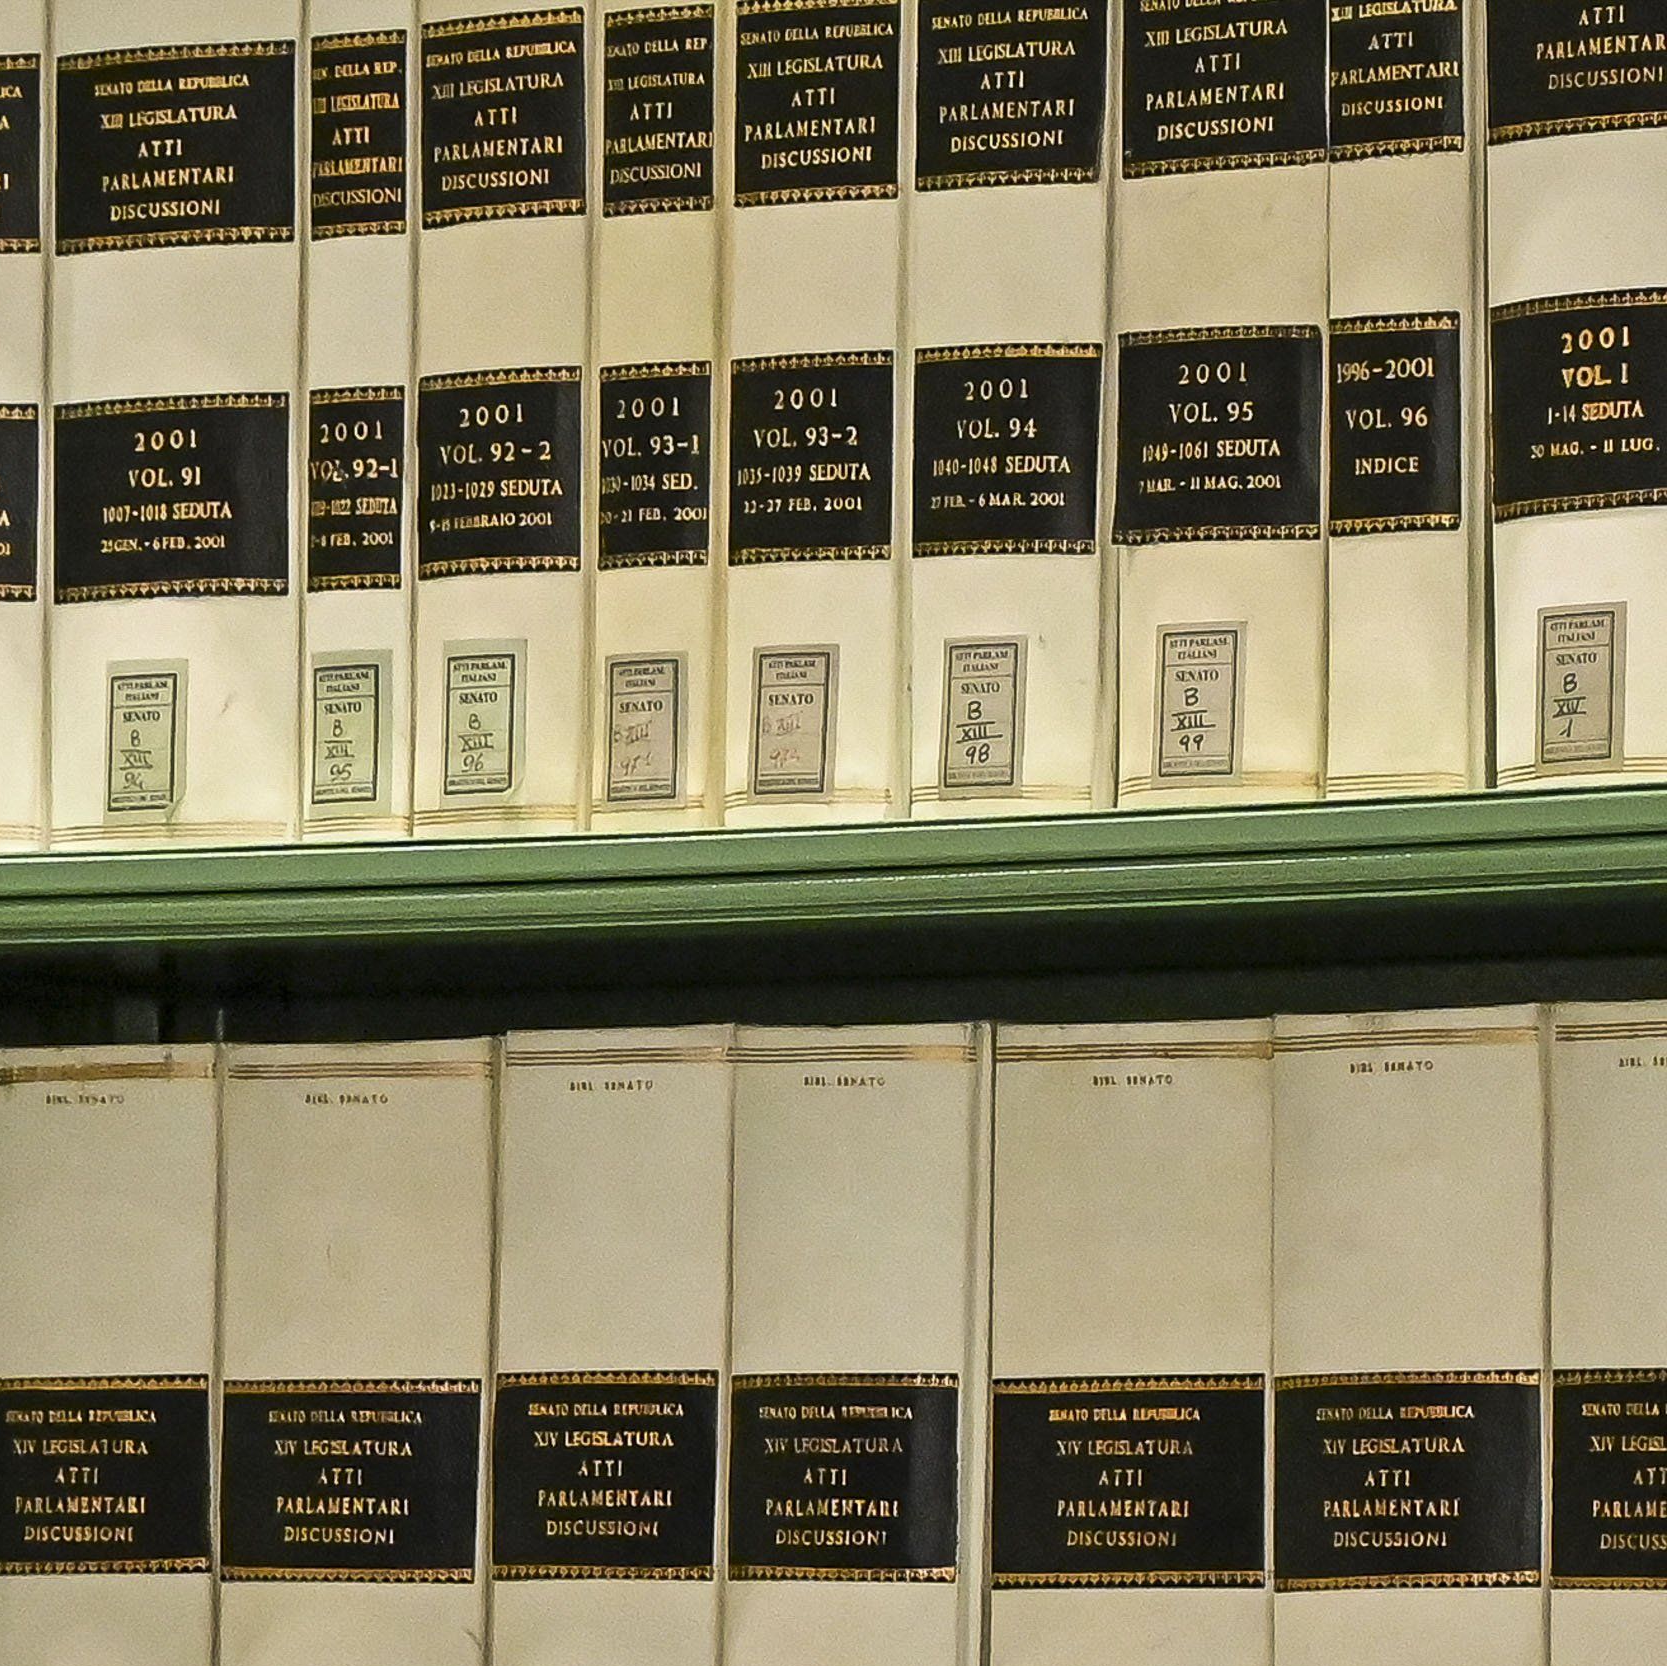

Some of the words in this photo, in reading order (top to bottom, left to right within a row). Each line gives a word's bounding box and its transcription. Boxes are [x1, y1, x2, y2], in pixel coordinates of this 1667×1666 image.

[932, 15, 972, 30] SENATO
[978, 12, 1011, 25] DELLA
[1579, 5, 1624, 25] ATTI
[1176, 19, 1287, 44] LEGISLATURA
[1368, 32, 1413, 50] ATTI
[968, 41, 1075, 62] LEGISLATURA
[778, 55, 883, 75] LEGISLATURA
[1195, 53, 1240, 73] ATTI
[981, 70, 1023, 89] ATTI
[1331, 61, 1459, 87] PARLAMENTARI
[1549, 66, 1662, 89] DISCUSSIONI
[460, 73, 563, 96] LEGISLATURA
[792, 88, 834, 107] ATTI
[1146, 83, 1283, 111] PARLAMENTARI
[1342, 96, 1442, 116] DISCUSSIONI
[130, 104, 237, 127] LEGISLATURA
[475, 107, 516, 126] ATTI
[630, 102, 672, 120] ATTI
[940, 99, 1074, 123] PARLAMENTARI
[333, 126, 369, 145] ATTI
[745, 117, 875, 142] PARLAMENTARI
[1158, 117, 1273, 141] DISCUSSIONI
[139, 139, 182, 157] ATTI
[435, 136, 562, 162] PARLAMENTARI
[606, 132, 712, 154] PARLAMENTARI
[951, 130, 1063, 152] DISCUSSIONI
[762, 146, 871, 169] DISCUSSIONI
[103, 166, 233, 192] PARLAMENTARI
[442, 169, 548, 191] DISCUSSIONI
[610, 162, 701, 184] DISCUSSIONI
[313, 188, 401, 207] DISCUSSIONI
[111, 199, 219, 221] DISCUSSIONI
[1562, 326, 1629, 353] 2001
[1179, 362, 1246, 384] 2001
[1337, 357, 1434, 383] 1996-2001
[775, 389, 836, 409] 2001
[965, 379, 1028, 400] 2001
[460, 404, 522, 427] 2001
[617, 397, 679, 418] 2001
[1169, 402, 1218, 423] VOL.
[1227, 401, 1253, 421] 95
[1548, 404, 1576, 424] 1-14
[1582, 400, 1644, 421] SEDUTA
[1346, 409, 1391, 429] VOL.
[1401, 407, 1427, 426] 96
[321, 420, 382, 443] 2001
[754, 428, 796, 447] VOL.
[957, 418, 999, 438] VOL.
[1010, 418, 1037, 437] 94
[135, 429, 196, 451] 2001
[602, 437, 641, 458] VOL.
[1217, 439, 1280, 457] SEDUTA
[1621, 438, 1659, 451] LUG.
[440, 444, 482, 464] VOL.
[809, 463, 871, 481] SEDUTA
[1006, 456, 1070, 473] SEDUTA
[1356, 457, 1418, 475] INDICE
[129, 468, 173, 487] VOL.
[182, 466, 200, 485] 91
[662, 473, 698, 489] SED.
[1247, 475, 1281, 488] 2001
[501, 479, 562, 497] SEDUTA
[824, 497, 862, 511] 2001
[1030, 492, 1065, 506] 2001
[173, 502, 232, 520] SEDUTA
[519, 512, 552, 526] 2001
[674, 507, 707, 520] 2001
[363, 532, 393, 545] 2001
[1175, 669, 1219, 682] SENATO
[1179, 734, 1203, 752] 99
[966, 743, 990, 764] 98
[765, 1438, 788, 1454] XIV
[1324, 1439, 1346, 1454] XIV
[1353, 1437, 1465, 1455] LEGISLATURA
[57, 1467, 98, 1484] ATTI
[320, 1468, 361, 1485] ATTI
[578, 1460, 622, 1476] ATTI
[804, 1468, 846, 1485] ATTI
[1099, 1469, 1141, 1486] ATTI
[1365, 1469, 1409, 1486] ATTI
[277, 1496, 408, 1515] PARLAMENTARI
[1058, 1500, 1188, 1517] PARLAMENTARI
[1324, 1499, 1459, 1517] PARLAMENTARI
[24, 1526, 133, 1542] DISCUSSIONI
[284, 1526, 393, 1544] DISCUSSIONI
[547, 1520, 657, 1536] DISCUSSIONI
[776, 1529, 886, 1545] DISCUSSIONI
[1067, 1530, 1176, 1547] DISCUSSIONI
[1334, 1532, 1446, 1547] DISCUSSIONI
